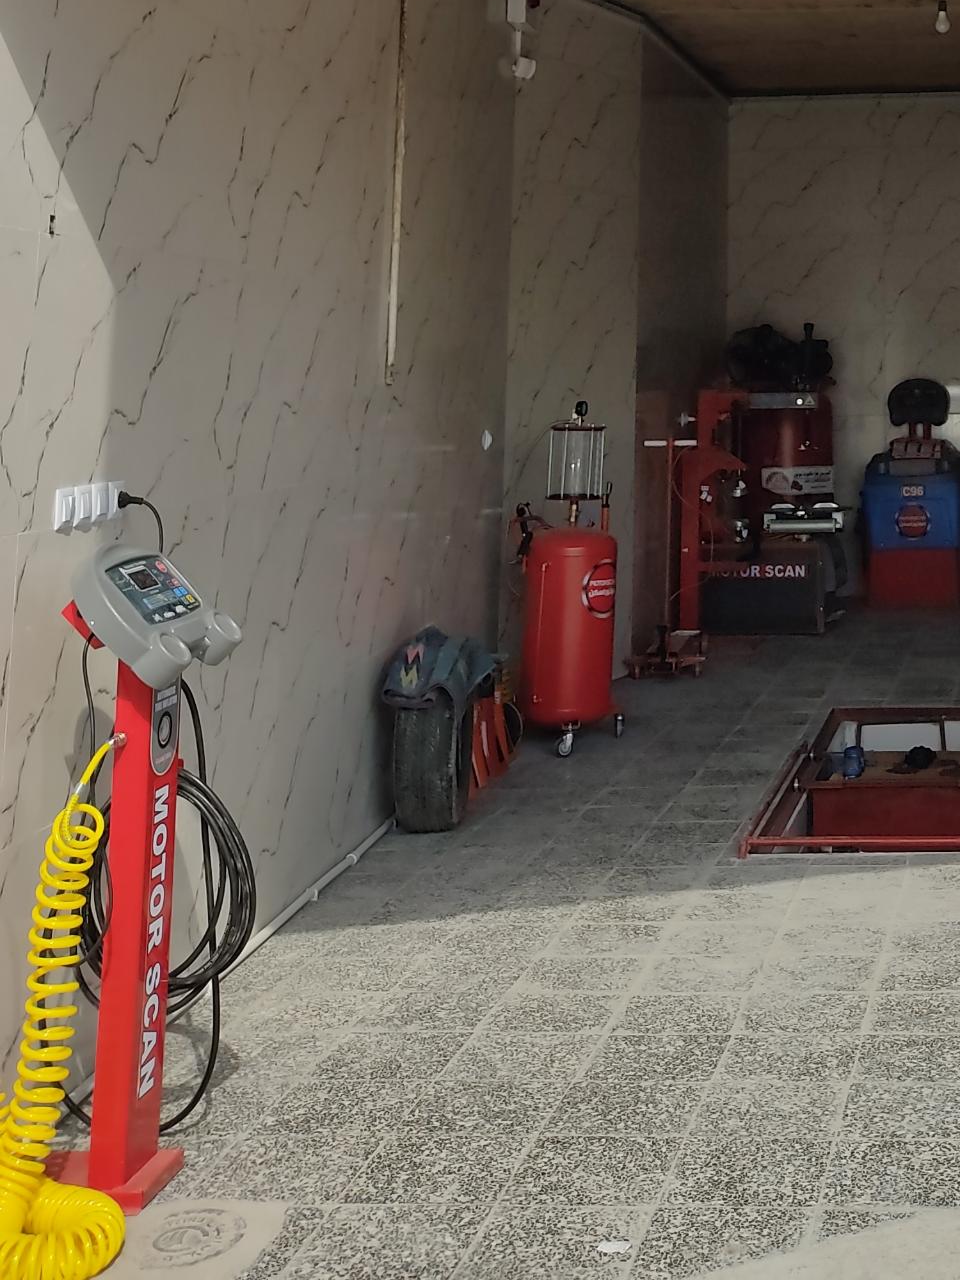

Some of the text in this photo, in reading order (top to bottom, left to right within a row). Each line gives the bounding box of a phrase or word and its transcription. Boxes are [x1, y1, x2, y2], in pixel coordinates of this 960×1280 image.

[902, 486, 924, 497] C96
[765, 565, 805, 577] SCAN
[146, 785, 169, 955] MOTOR
[136, 963, 161, 1100] SCAN
